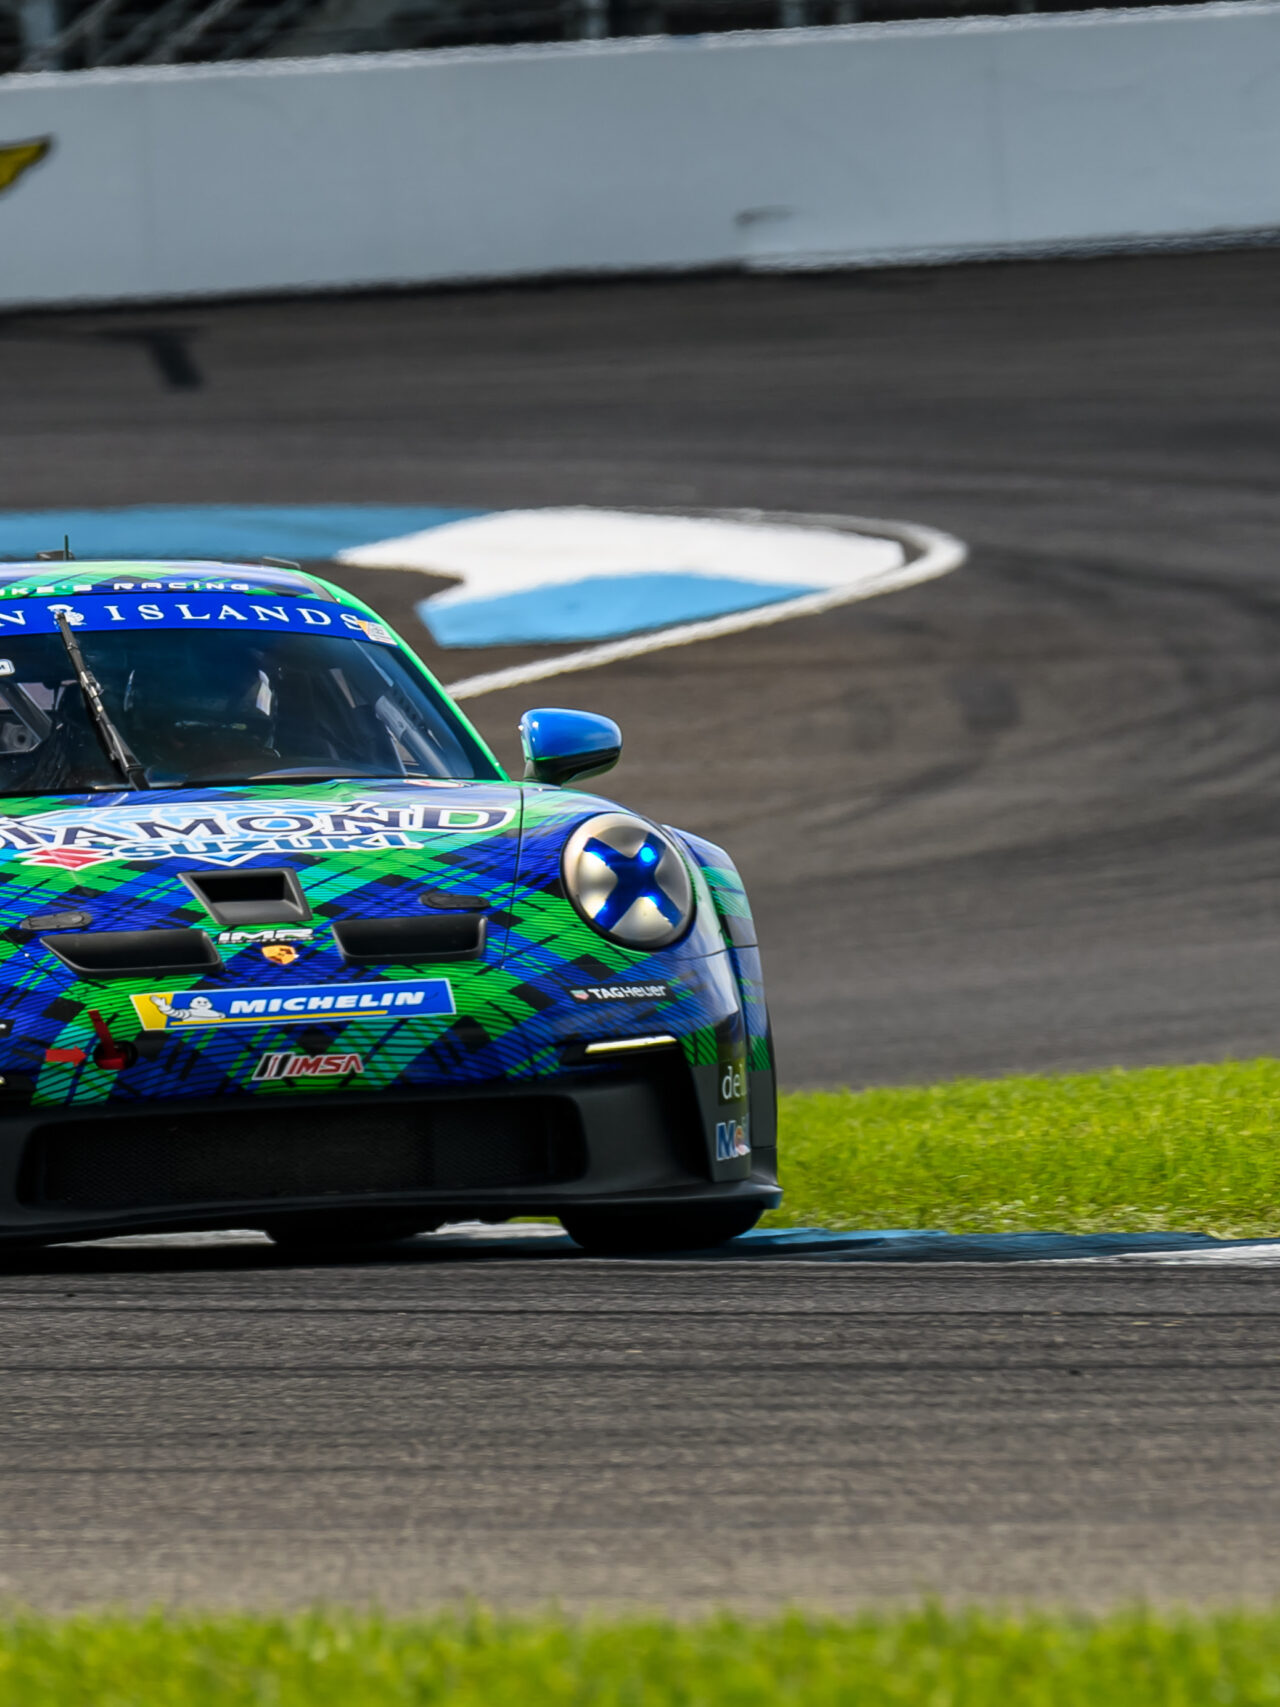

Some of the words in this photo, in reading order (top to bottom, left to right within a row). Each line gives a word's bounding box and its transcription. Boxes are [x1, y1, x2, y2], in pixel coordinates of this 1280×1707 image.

[113, 581, 250, 591] RACING
[103, 603, 364, 631] ISLANDS
[116, 832, 412, 859] SUZUKI
[218, 928, 314, 942] IMR
[229, 991, 425, 1015] MICHELIN
[286, 1054, 364, 1077] IMSA
